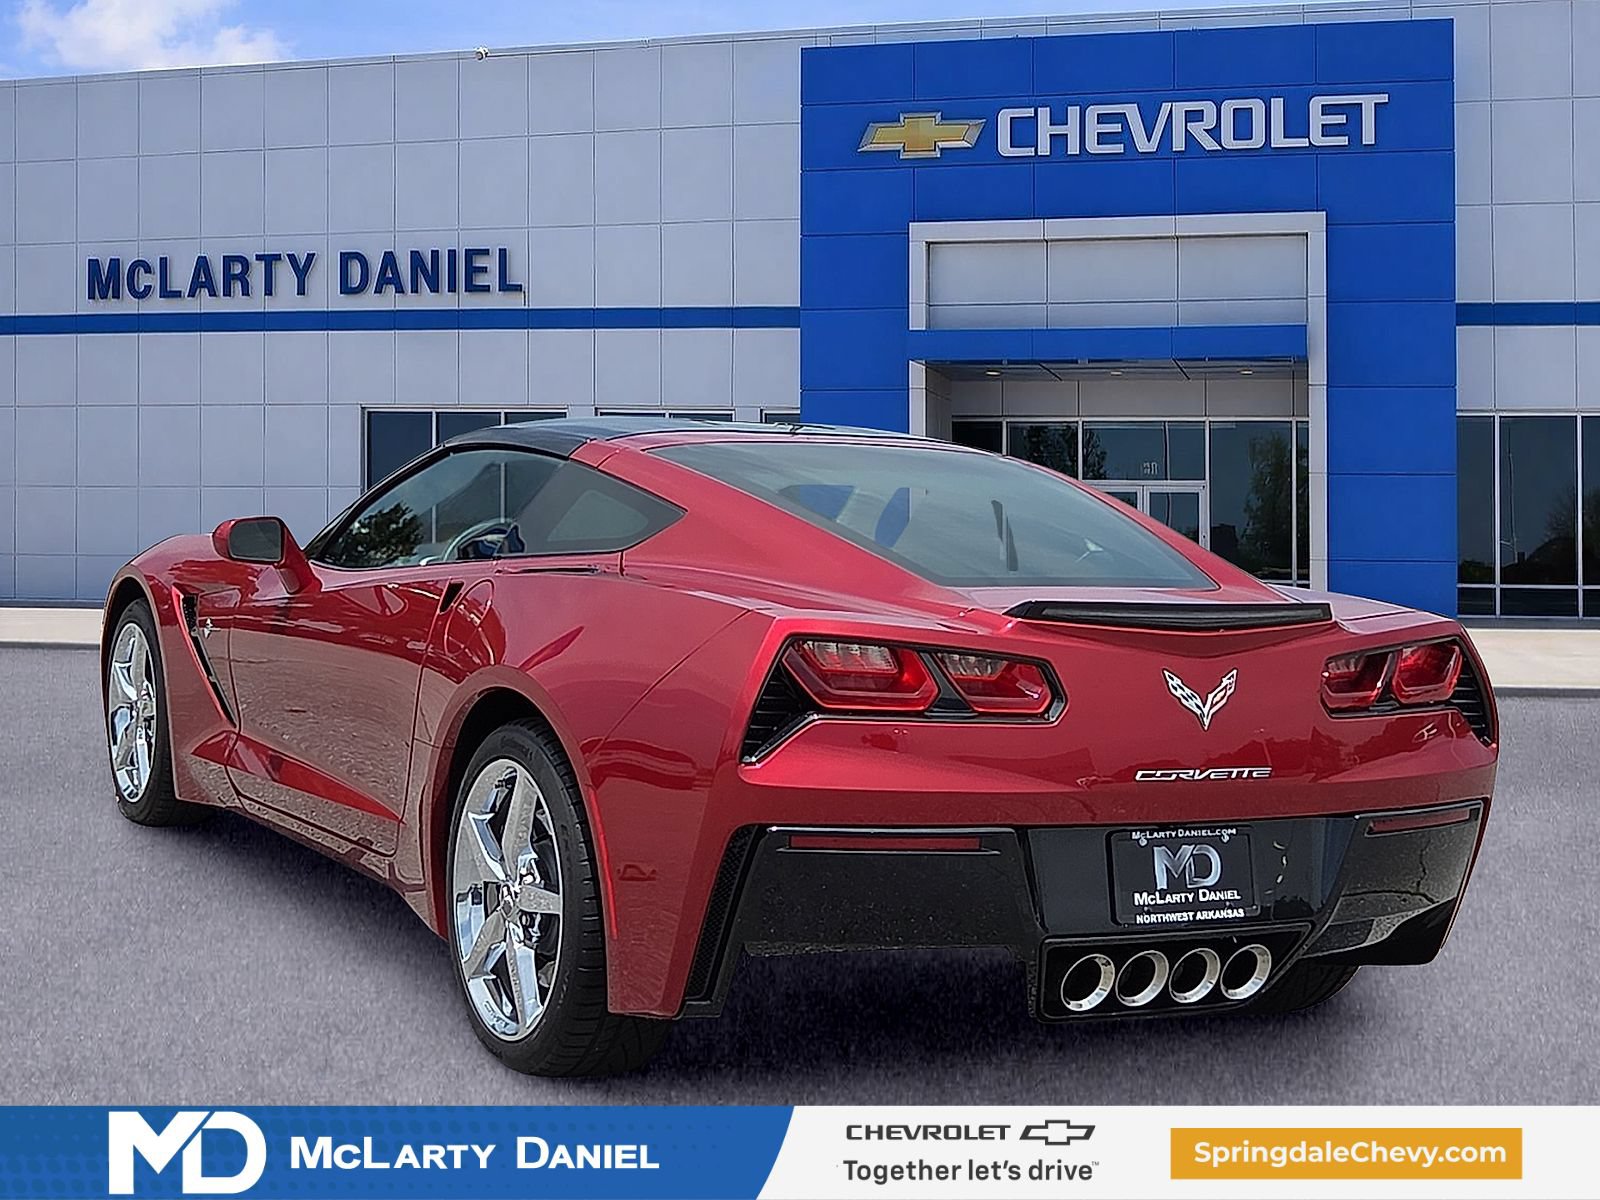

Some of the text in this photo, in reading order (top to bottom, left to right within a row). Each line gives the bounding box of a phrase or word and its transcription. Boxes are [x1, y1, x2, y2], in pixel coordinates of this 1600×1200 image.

[996, 94, 1389, 158] CHEVROLET
[339, 246, 524, 296] DANIEL
[1135, 767, 1273, 782] CORVETTE
[1153, 844, 1222, 890] MD
[1198, 889, 1241, 901] DANIEL
[1136, 908, 1245, 924] NORTHWEST ARKANSAS
